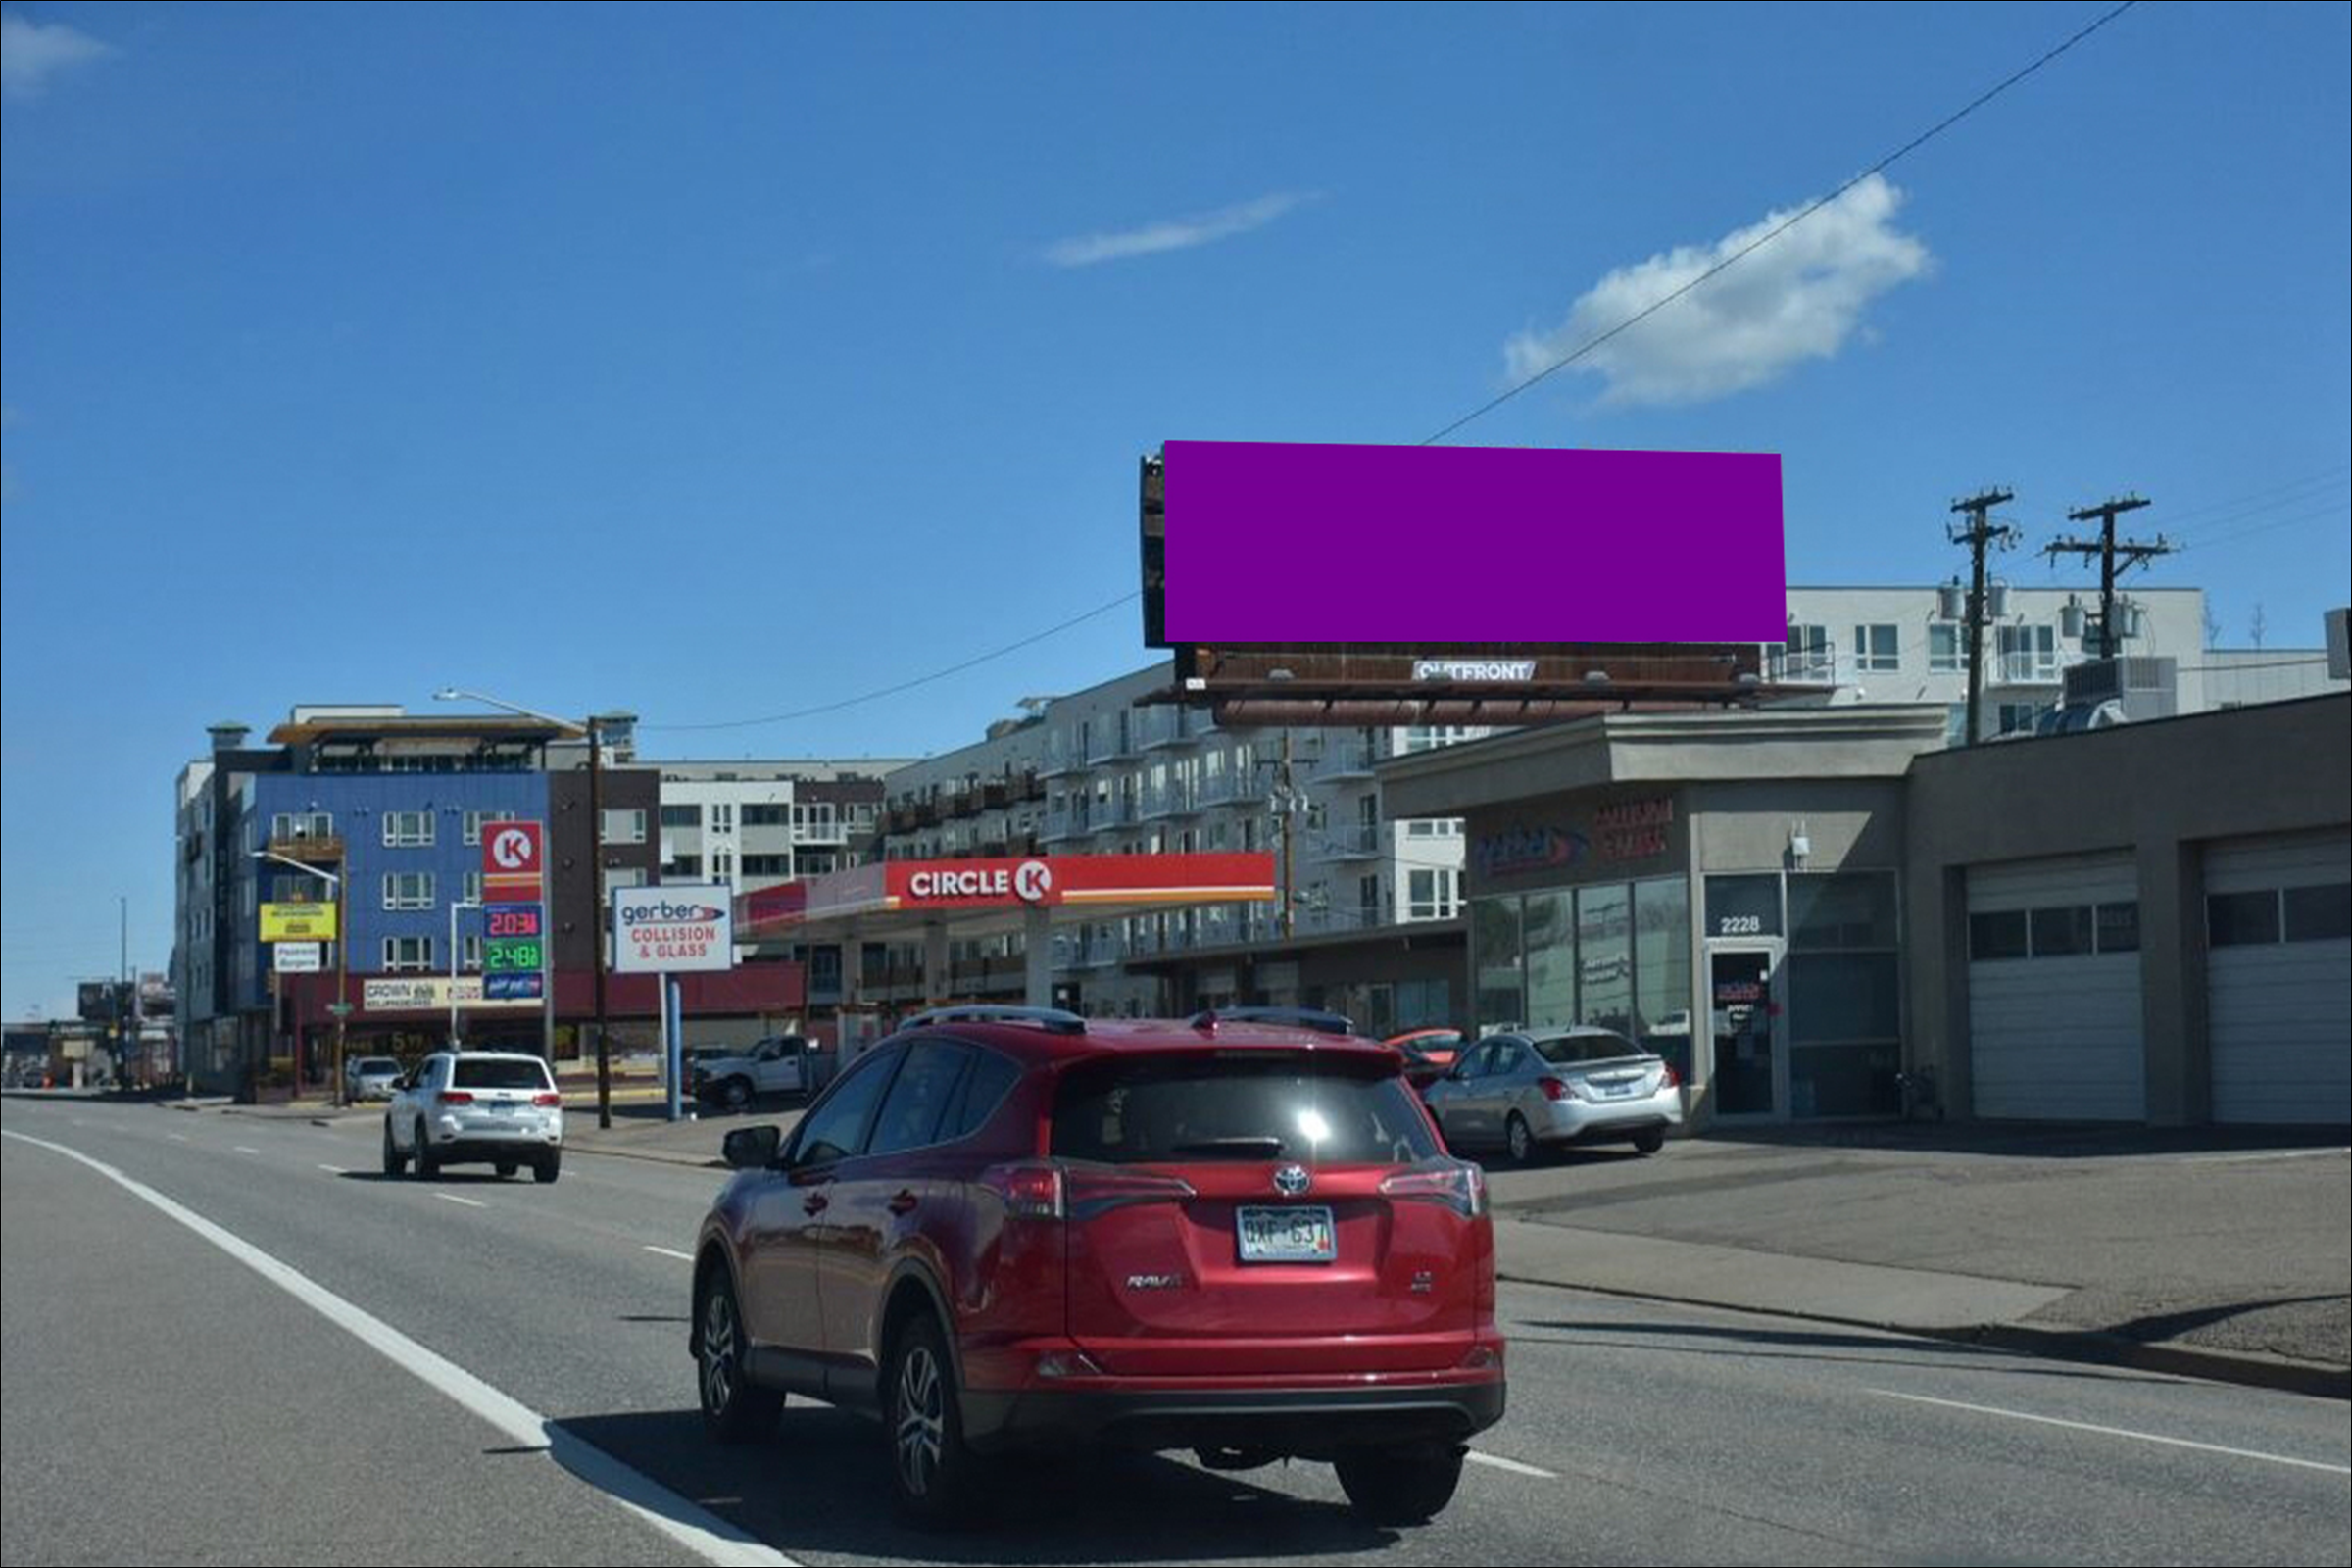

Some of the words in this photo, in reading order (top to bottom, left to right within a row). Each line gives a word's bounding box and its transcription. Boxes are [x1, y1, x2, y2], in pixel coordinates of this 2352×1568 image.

[500, 834, 531, 866] K
[910, 870, 1008, 896] CIRCLE
[1021, 866, 1050, 899] K
[621, 900, 699, 926] gerber
[631, 927, 715, 942] COLLISION
[1721, 916, 1761, 933] 2228
[657, 944, 706, 958] GLASS
